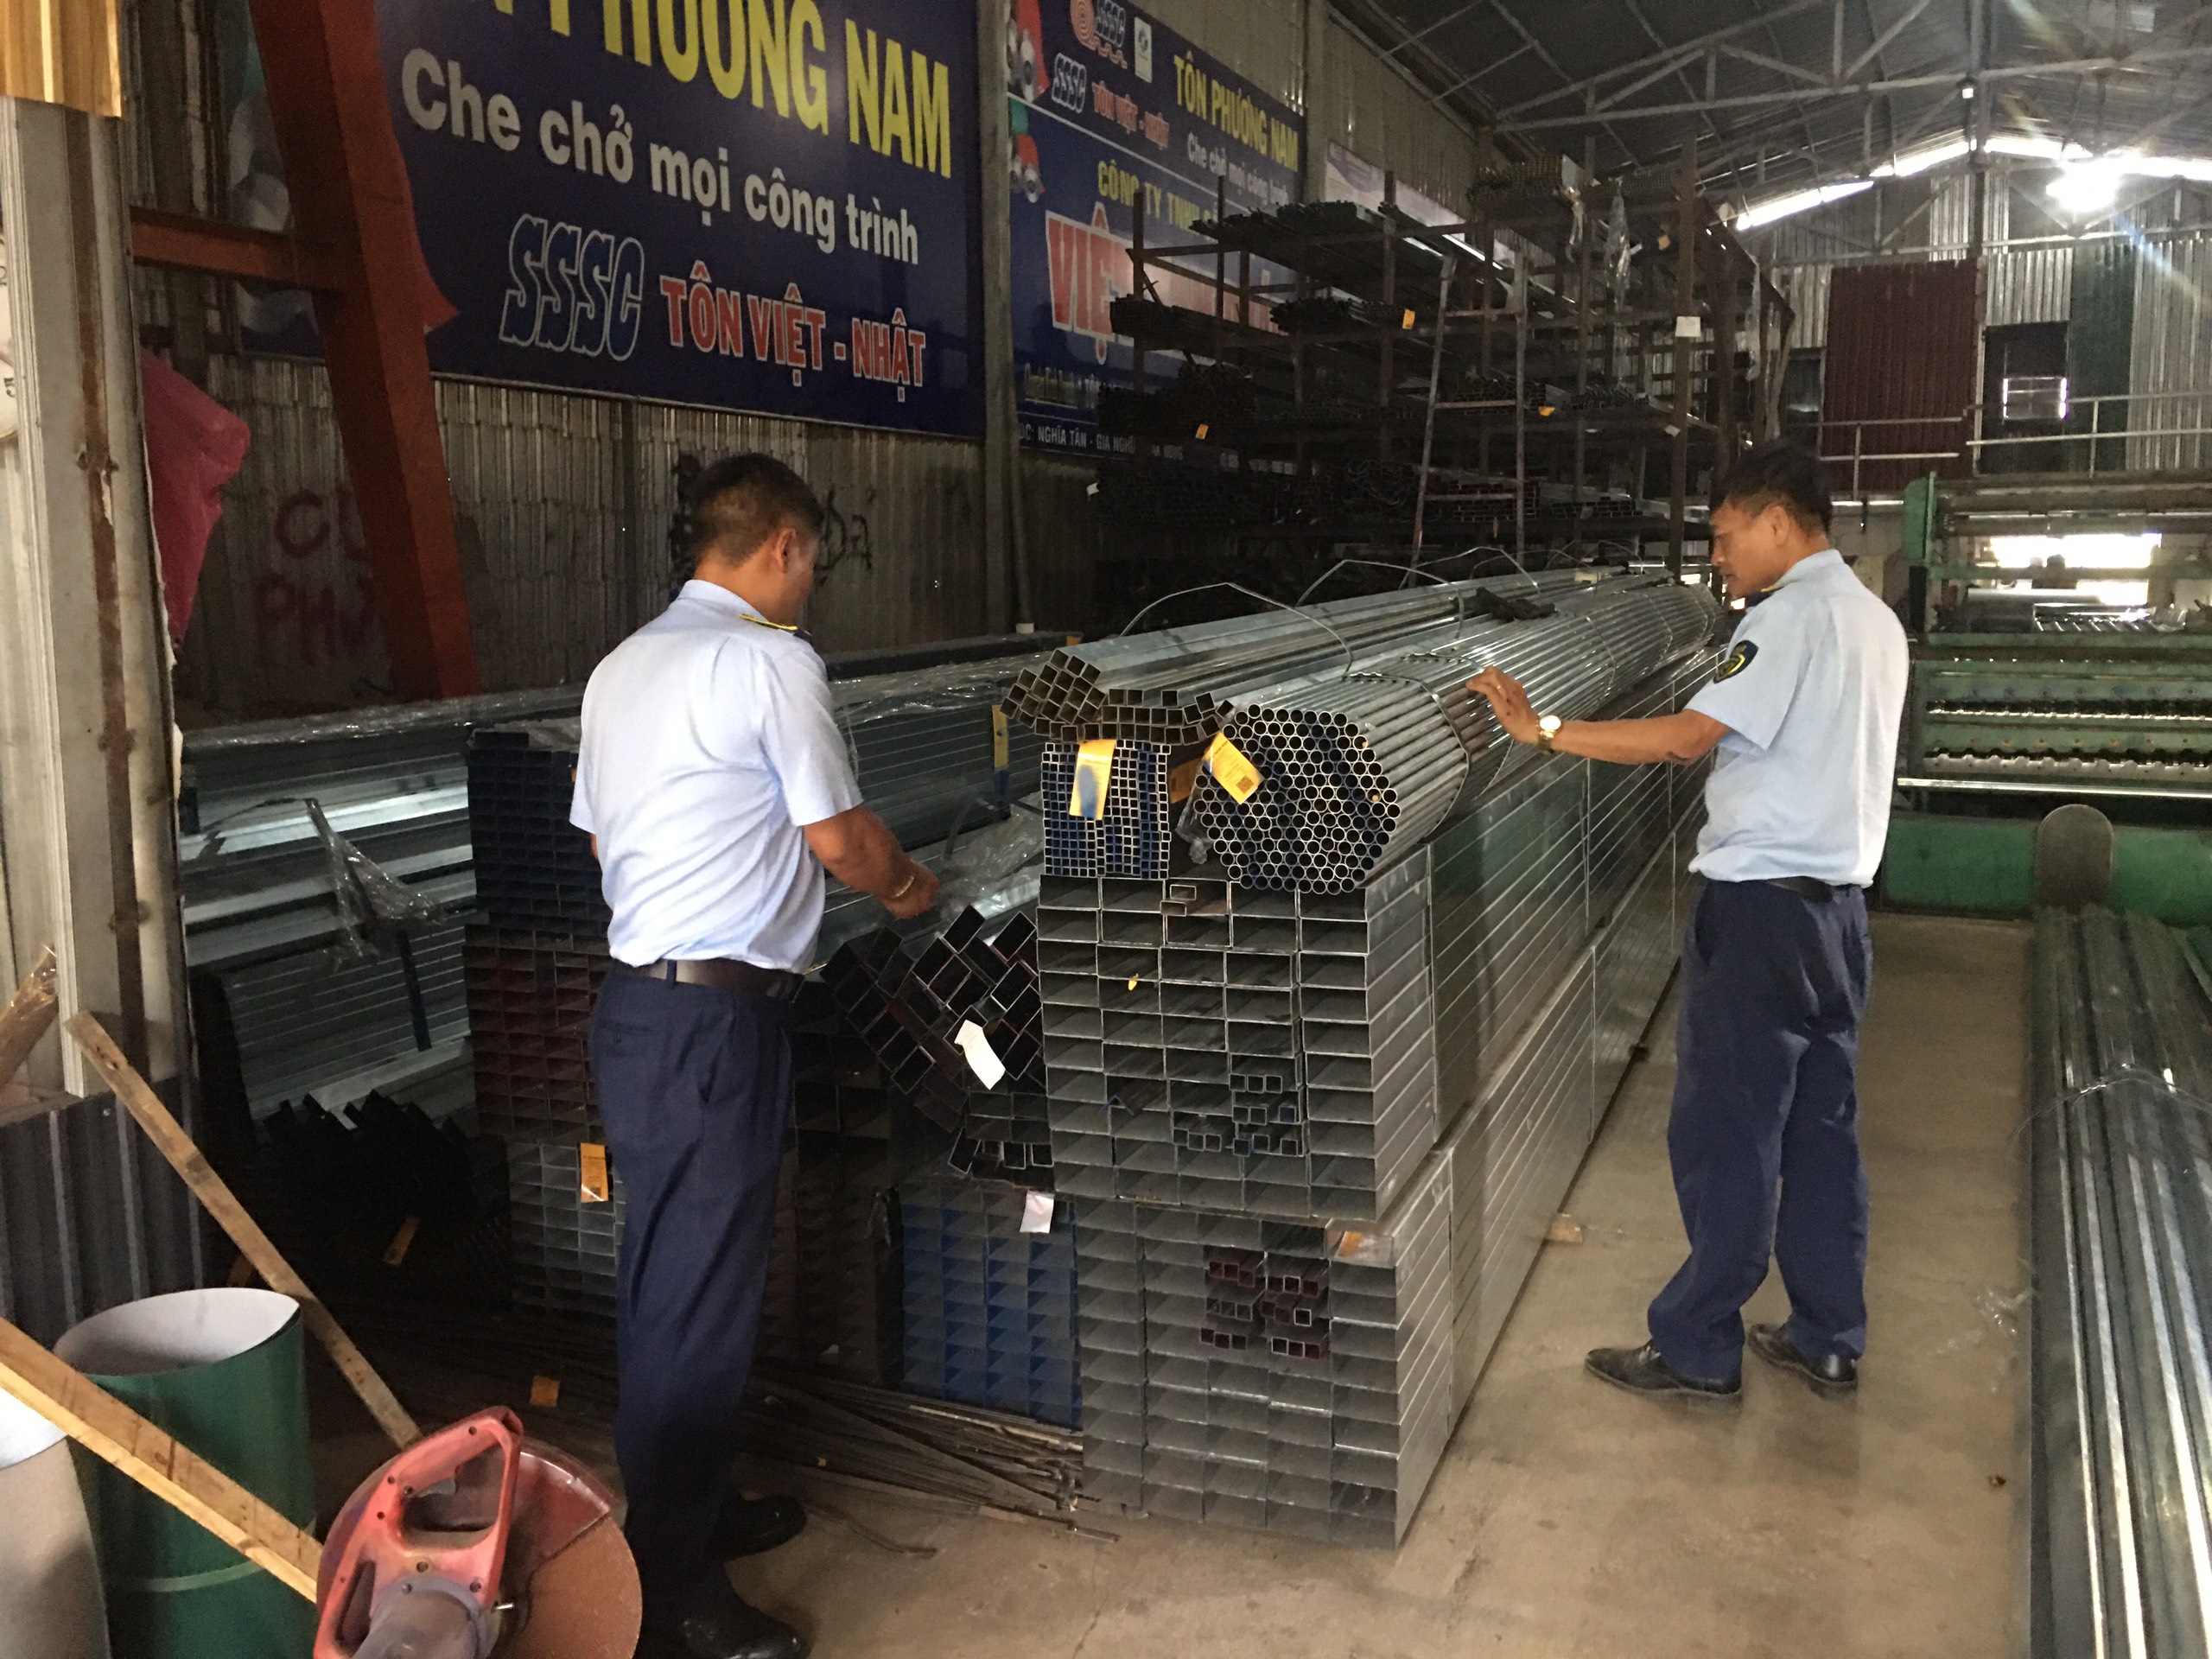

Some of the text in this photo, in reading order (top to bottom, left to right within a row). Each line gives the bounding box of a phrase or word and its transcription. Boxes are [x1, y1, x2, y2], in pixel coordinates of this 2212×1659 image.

[845, 18, 951, 179] NAM
[1052, 53, 1086, 113] SSSC
[1092, 80, 1115, 120] TÔN
[1115, 93, 1138, 134] VIỆT
[1173, 50, 1298, 172] TÔN PHƯƠNG NAM
[402, 48, 918, 264] Che chở mọi công trình
[1187, 131, 1207, 168] Che
[1210, 147, 1227, 175] chở
[1229, 162, 1245, 195] mọi
[1144, 183, 1162, 219] TY
[499, 214, 645, 361] SSSC
[660, 260, 743, 359] TÔN
[746, 283, 826, 386] VIỆT
[834, 342, 846, 361] -
[852, 308, 926, 402] NHẬT
[1038, 424, 1067, 447] NGHĨA
[1070, 427, 1087, 448] TÂN
[1096, 433, 1110, 451] GIA
